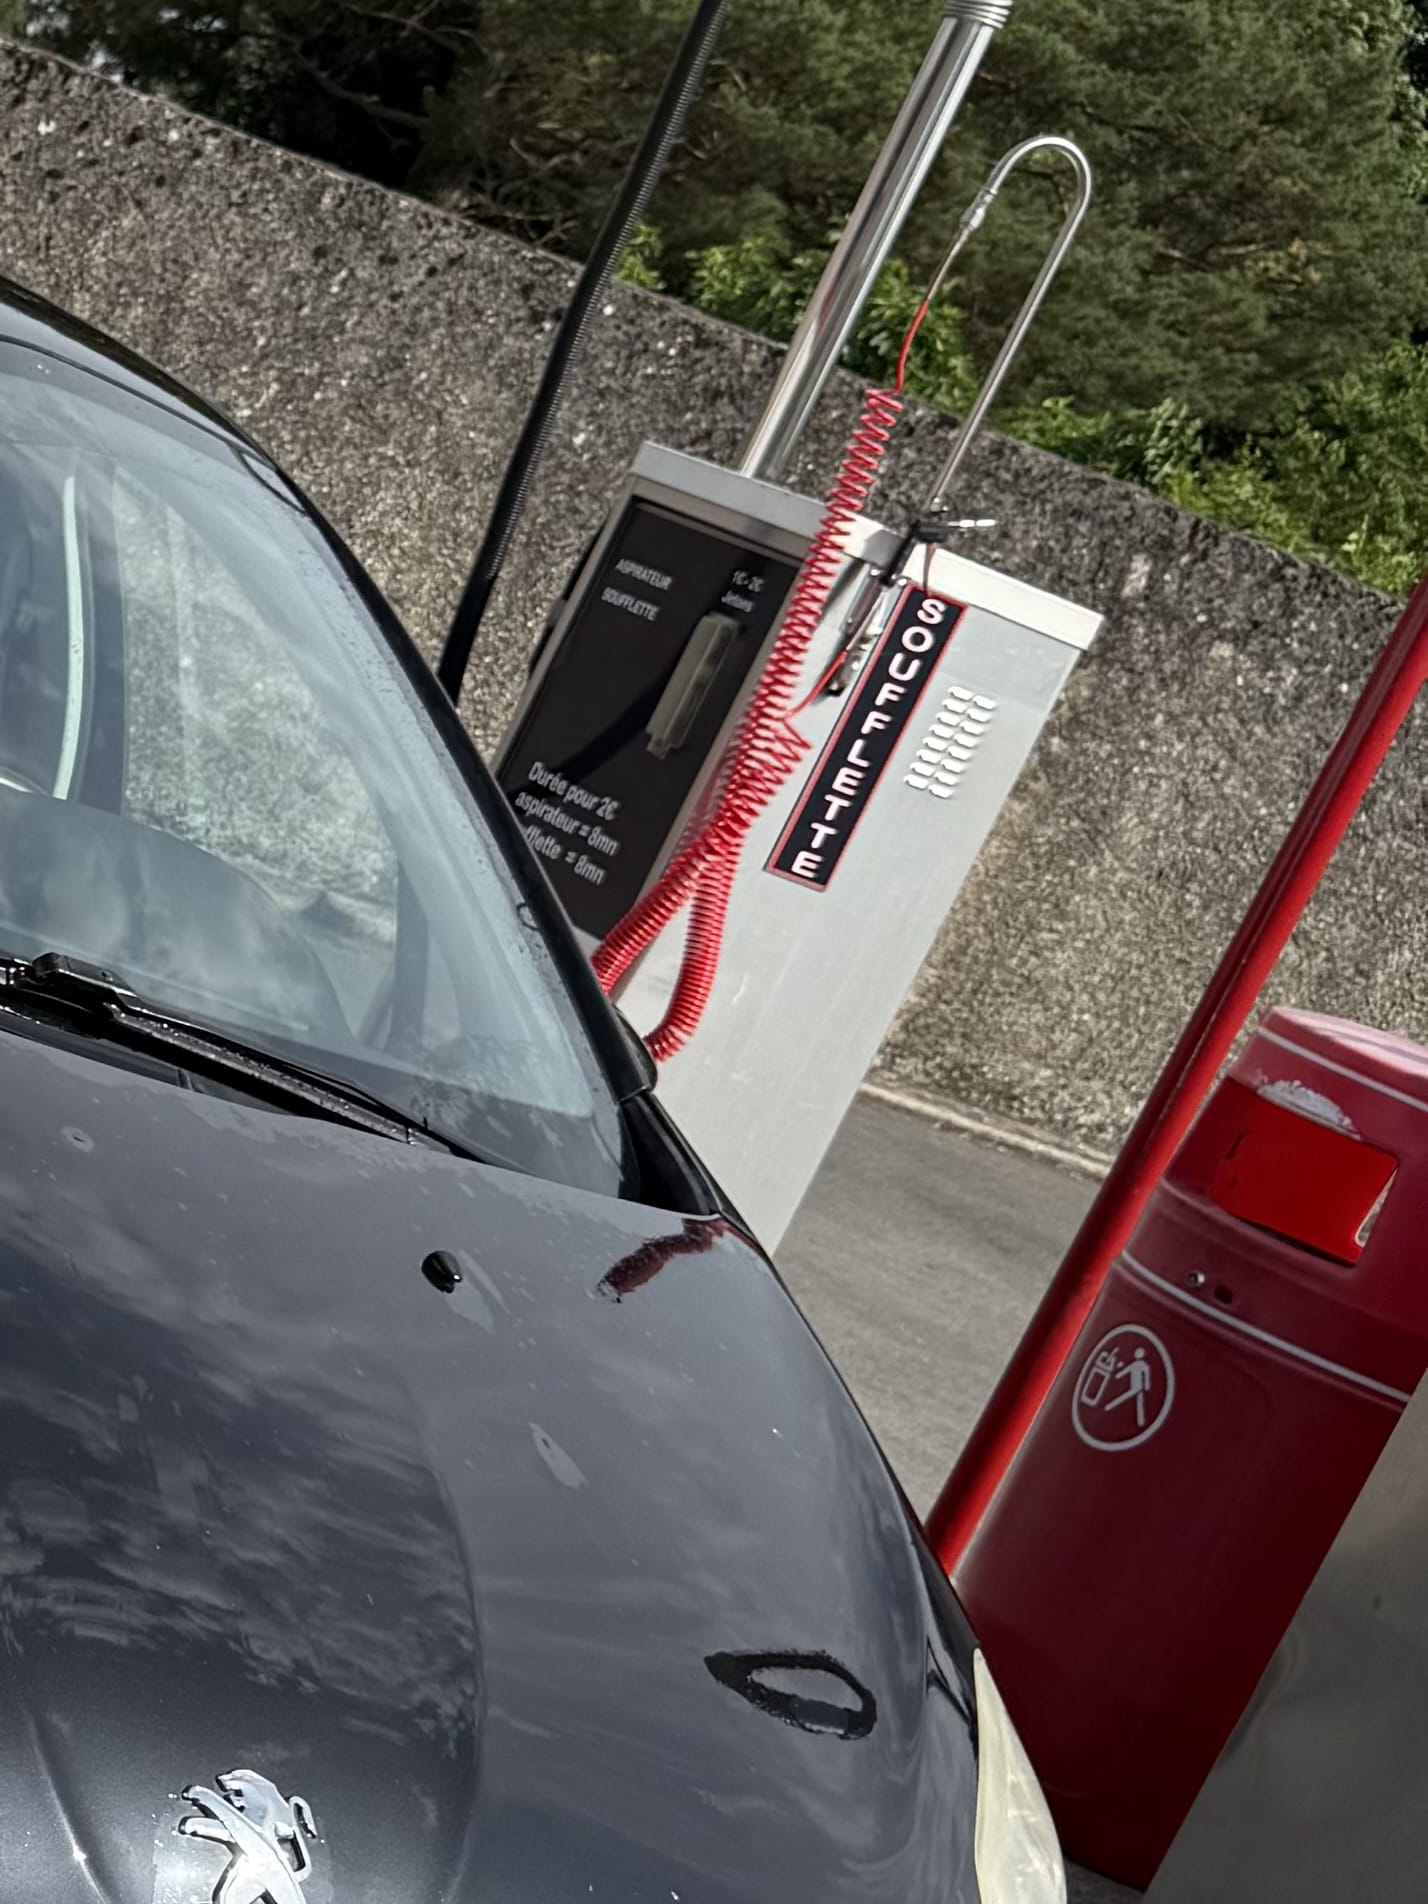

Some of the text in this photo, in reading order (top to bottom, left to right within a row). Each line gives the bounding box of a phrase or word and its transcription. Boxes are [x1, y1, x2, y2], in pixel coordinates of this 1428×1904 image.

[615, 558, 674, 591] ASPIRATEUR
[601, 587, 660, 622] SOUFFLETTE
[791, 598, 946, 879] SOUFFLETTE
[528, 761, 619, 821] Durée pour 2€
[515, 791, 580, 834] aspirateur
[587, 826, 619, 856] 8mn
[574, 855, 605, 885] 8mn
